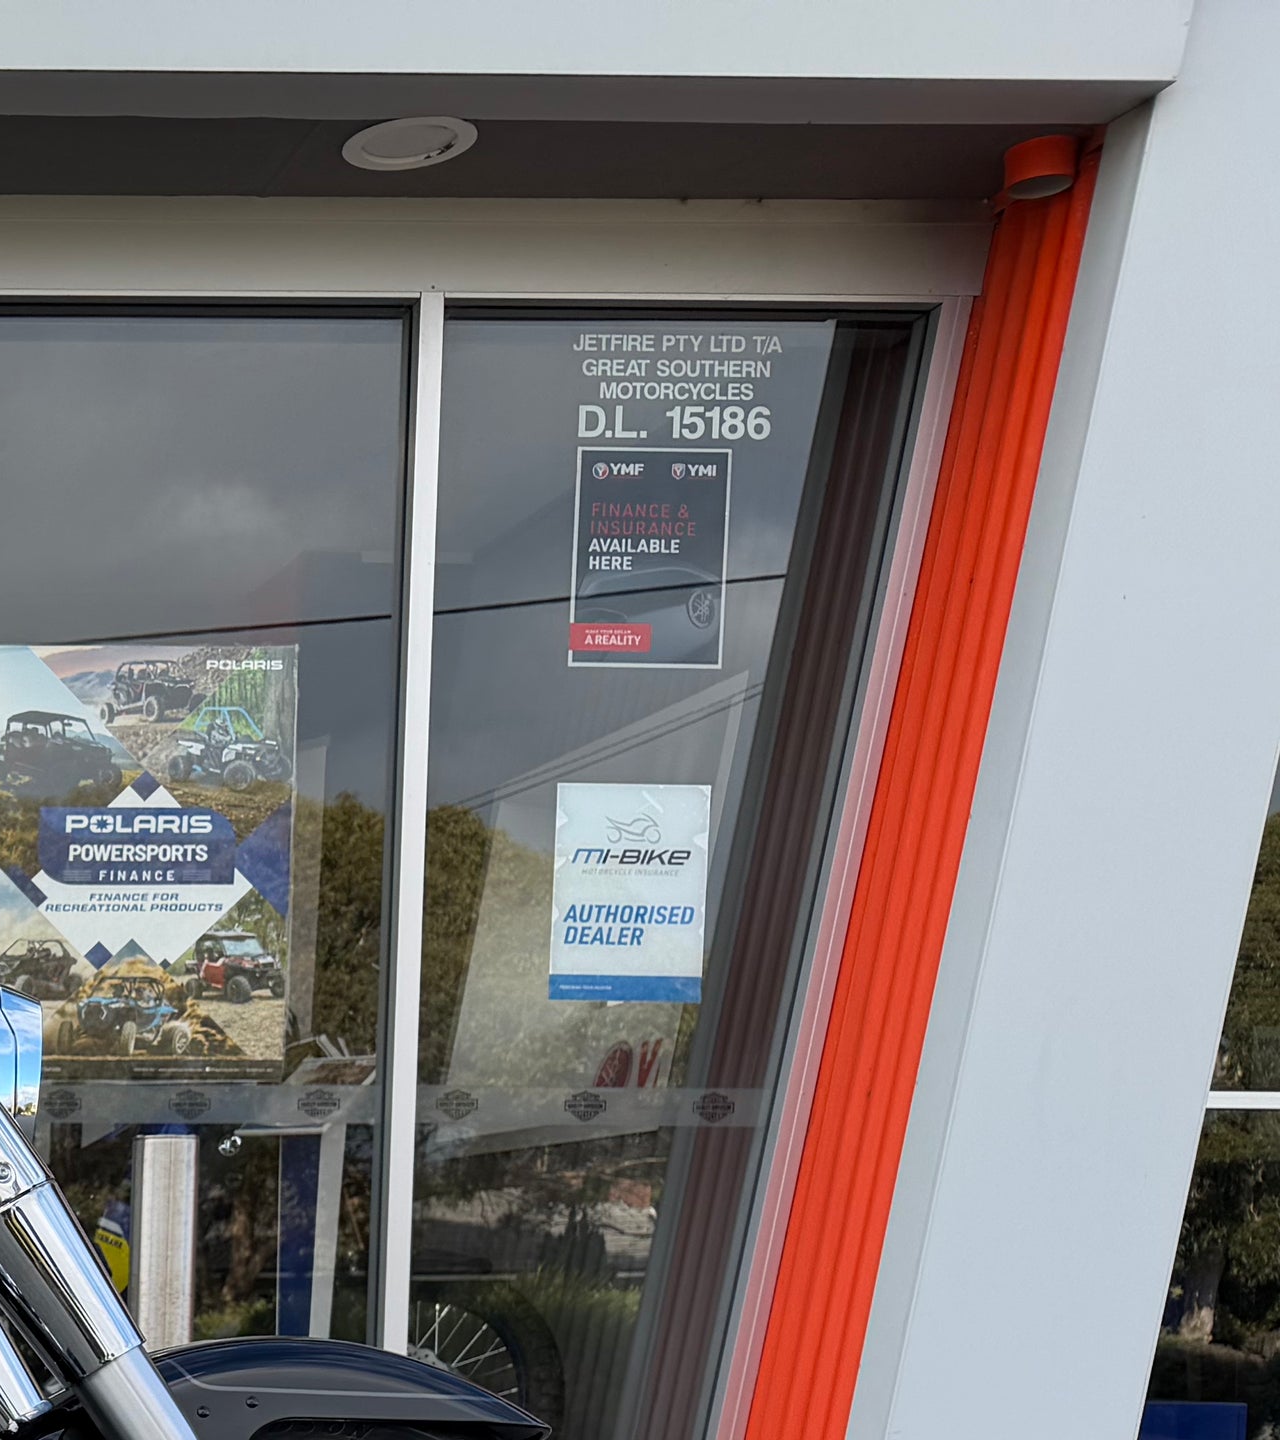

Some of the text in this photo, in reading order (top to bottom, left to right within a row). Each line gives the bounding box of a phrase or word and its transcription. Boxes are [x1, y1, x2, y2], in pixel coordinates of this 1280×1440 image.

[572, 333, 783, 355] JETFIRE PTY LTD T/A
[582, 359, 771, 378] GREAT SOUTHERN
[599, 382, 754, 401] MOTORCYCLES
[577, 405, 771, 441] D.L. 15186
[609, 463, 717, 478] YMF YMI
[592, 503, 689, 519] FINANCE &
[590, 521, 696, 537] INSURANCE
[588, 538, 680, 554] AVAILABLE
[589, 556, 632, 571] HERE
[585, 635, 641, 646] A REALITY
[206, 659, 284, 671] POLARIS
[65, 814, 213, 834] POLARIS
[68, 843, 208, 862] POWERSPORTS
[99, 869, 176, 882] FINANCE
[581, 868, 680, 877] MOTORCYCLE INSURANCE
[89, 892, 179, 902] FINANCE FOR
[44, 903, 224, 912] RECREATIONAL PRODUCTS
[563, 904, 696, 925] AUTHORISED
[563, 926, 645, 946] DEALER
